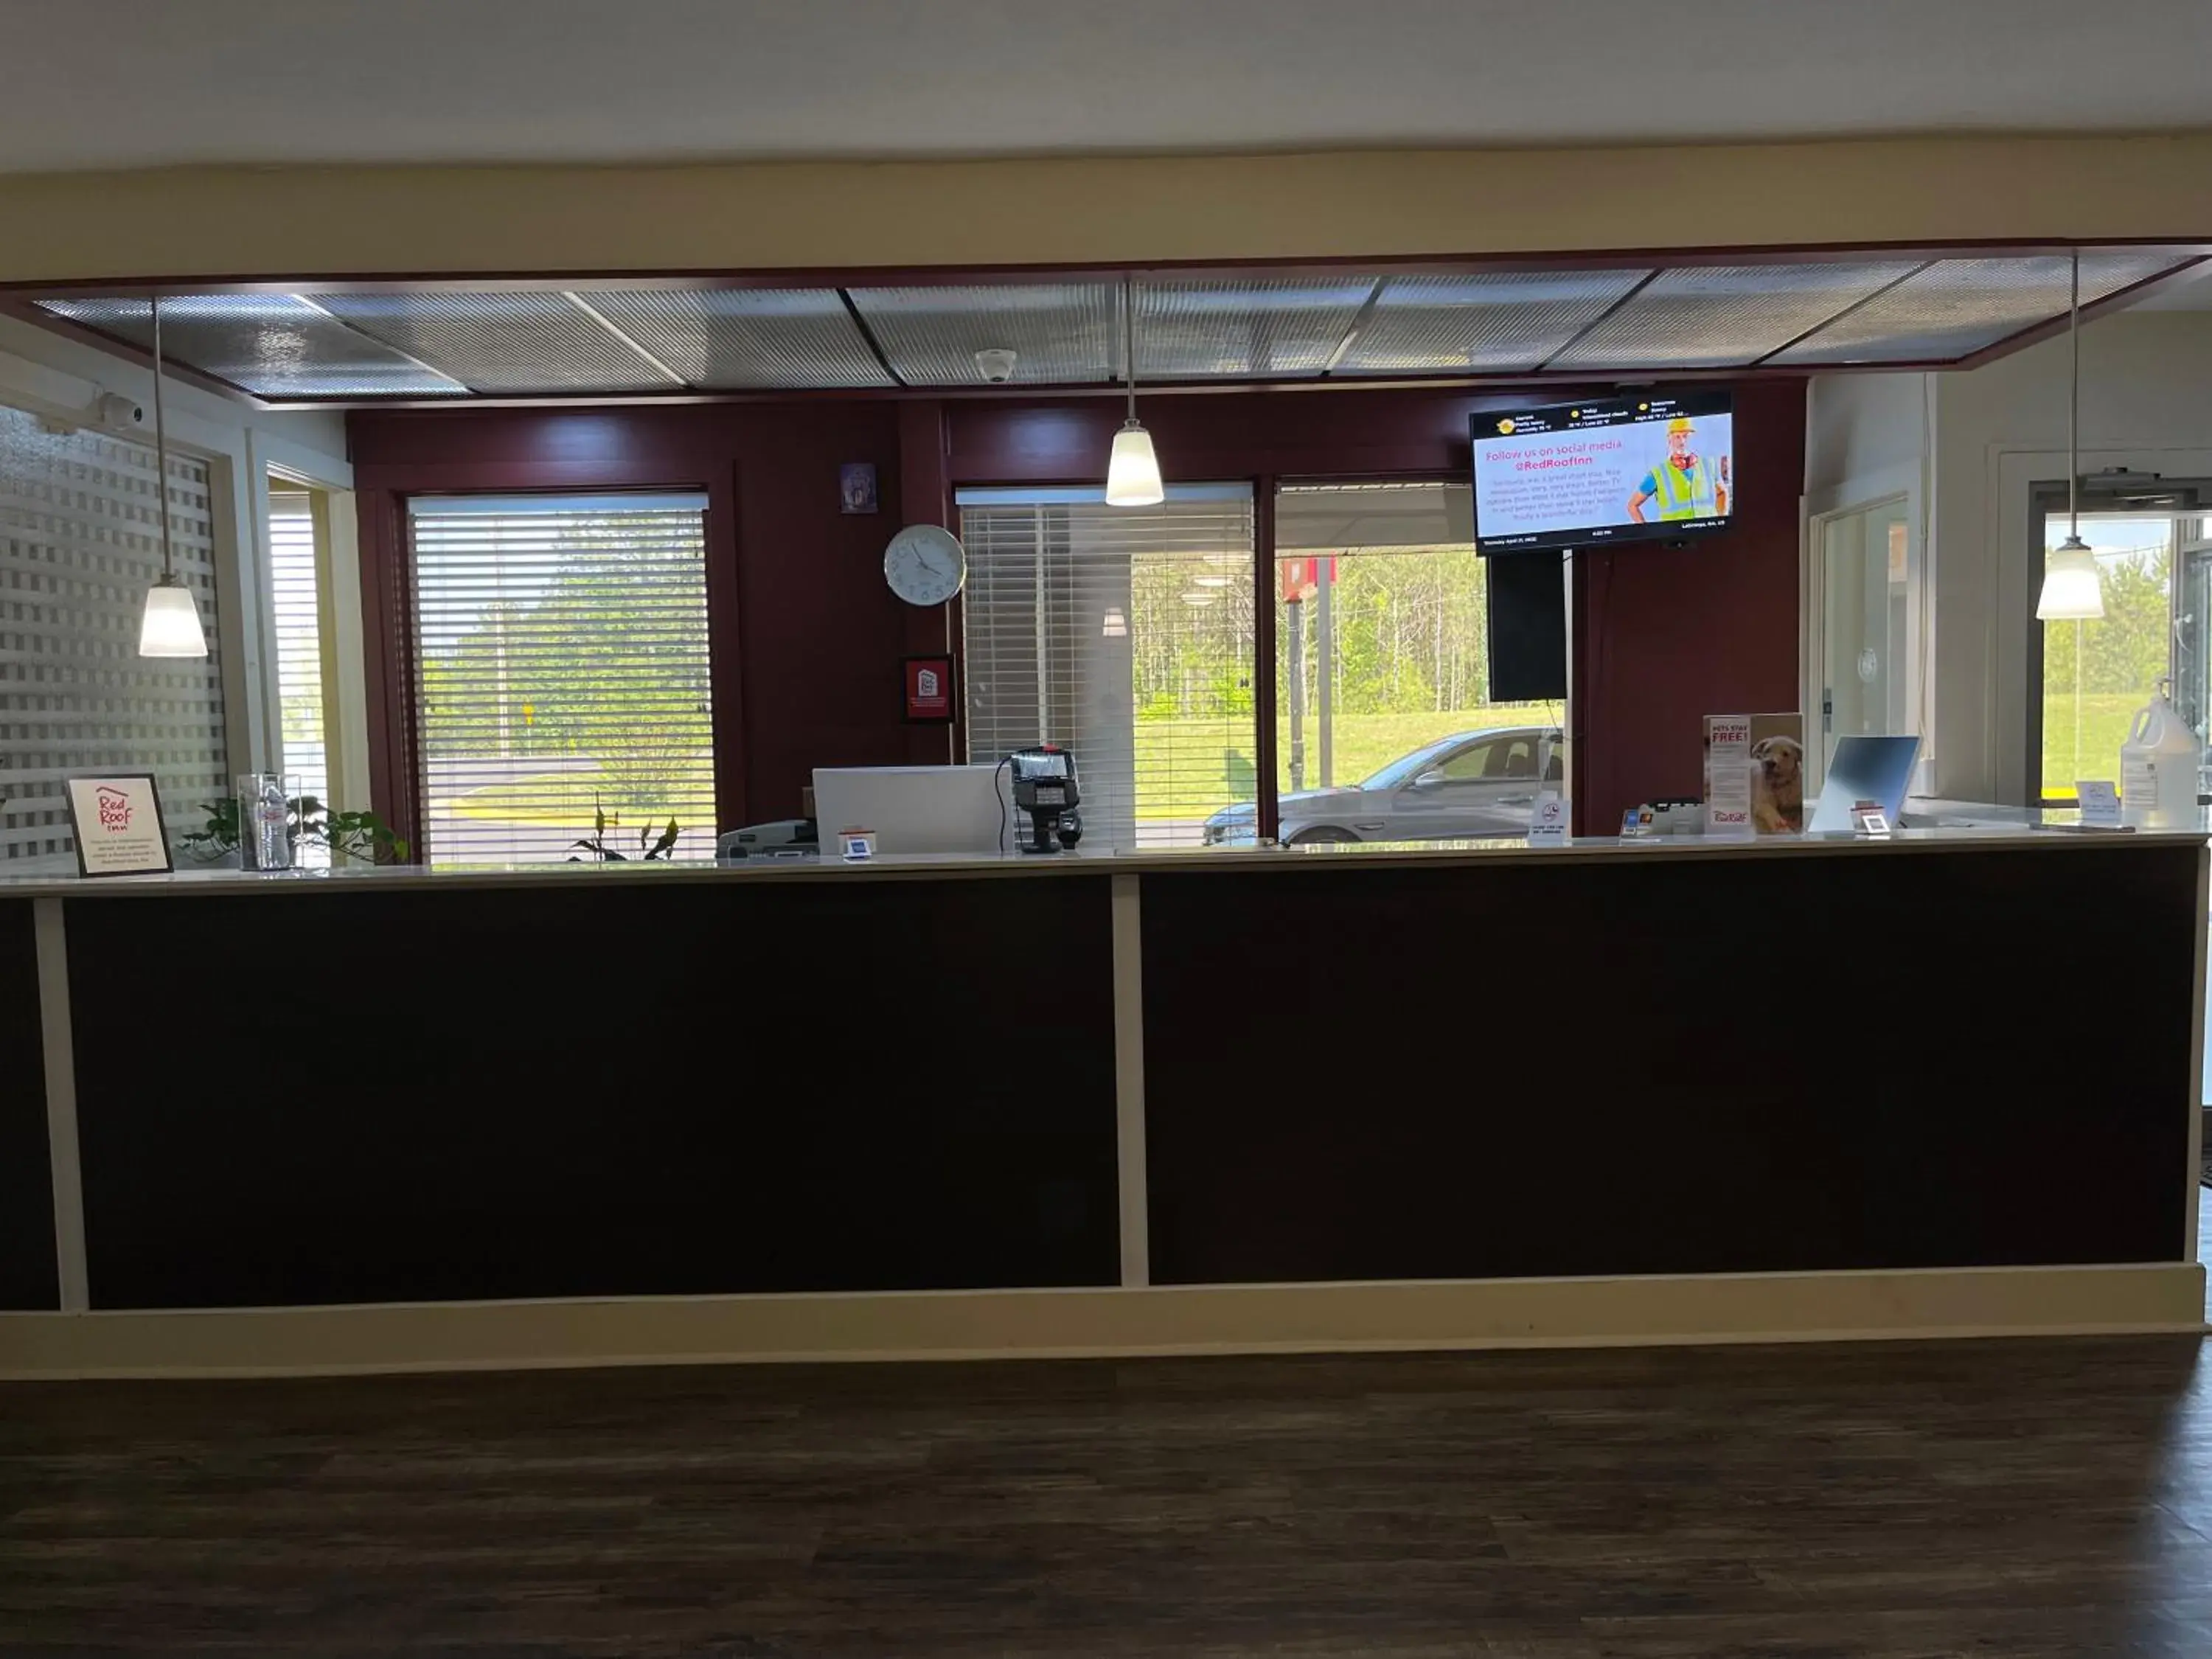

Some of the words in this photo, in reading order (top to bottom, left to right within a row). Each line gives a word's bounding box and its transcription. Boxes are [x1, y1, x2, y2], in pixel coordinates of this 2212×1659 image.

[1486, 451, 1521, 462] Follow
[1524, 450, 1536, 458] us
[1540, 447, 1554, 456] on
[1557, 443, 1586, 455] social
[1589, 439, 1622, 452] media
[1515, 456, 1593, 471] @RedRoofInn
[1712, 732, 1747, 742] FREE!
[99, 796, 125, 810] Red
[100, 807, 133, 825] Roof
